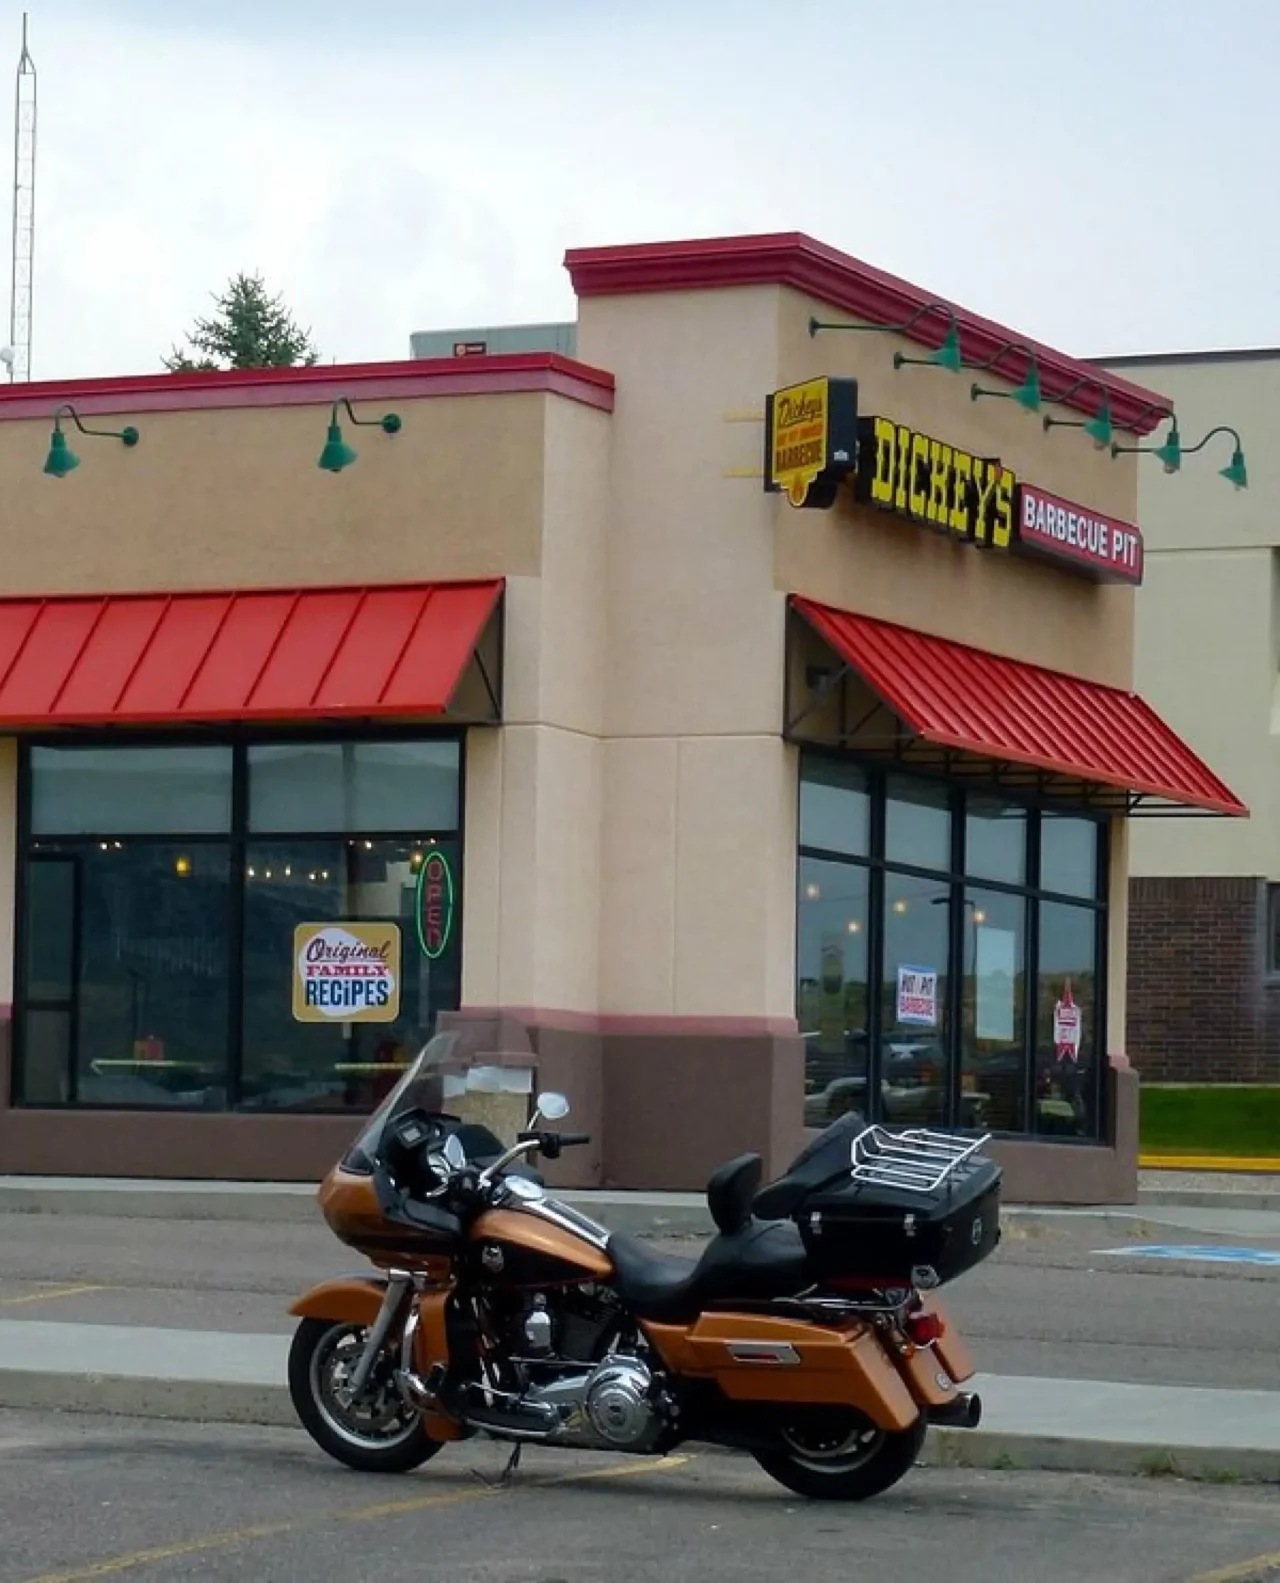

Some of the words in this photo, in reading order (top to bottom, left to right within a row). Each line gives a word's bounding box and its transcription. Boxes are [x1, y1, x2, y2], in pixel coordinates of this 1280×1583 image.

[1022, 494, 1109, 557] BARBECUE
[1111, 526, 1139, 567] PIT
[306, 937, 392, 964] Original
[306, 965, 389, 978] FAMILY
